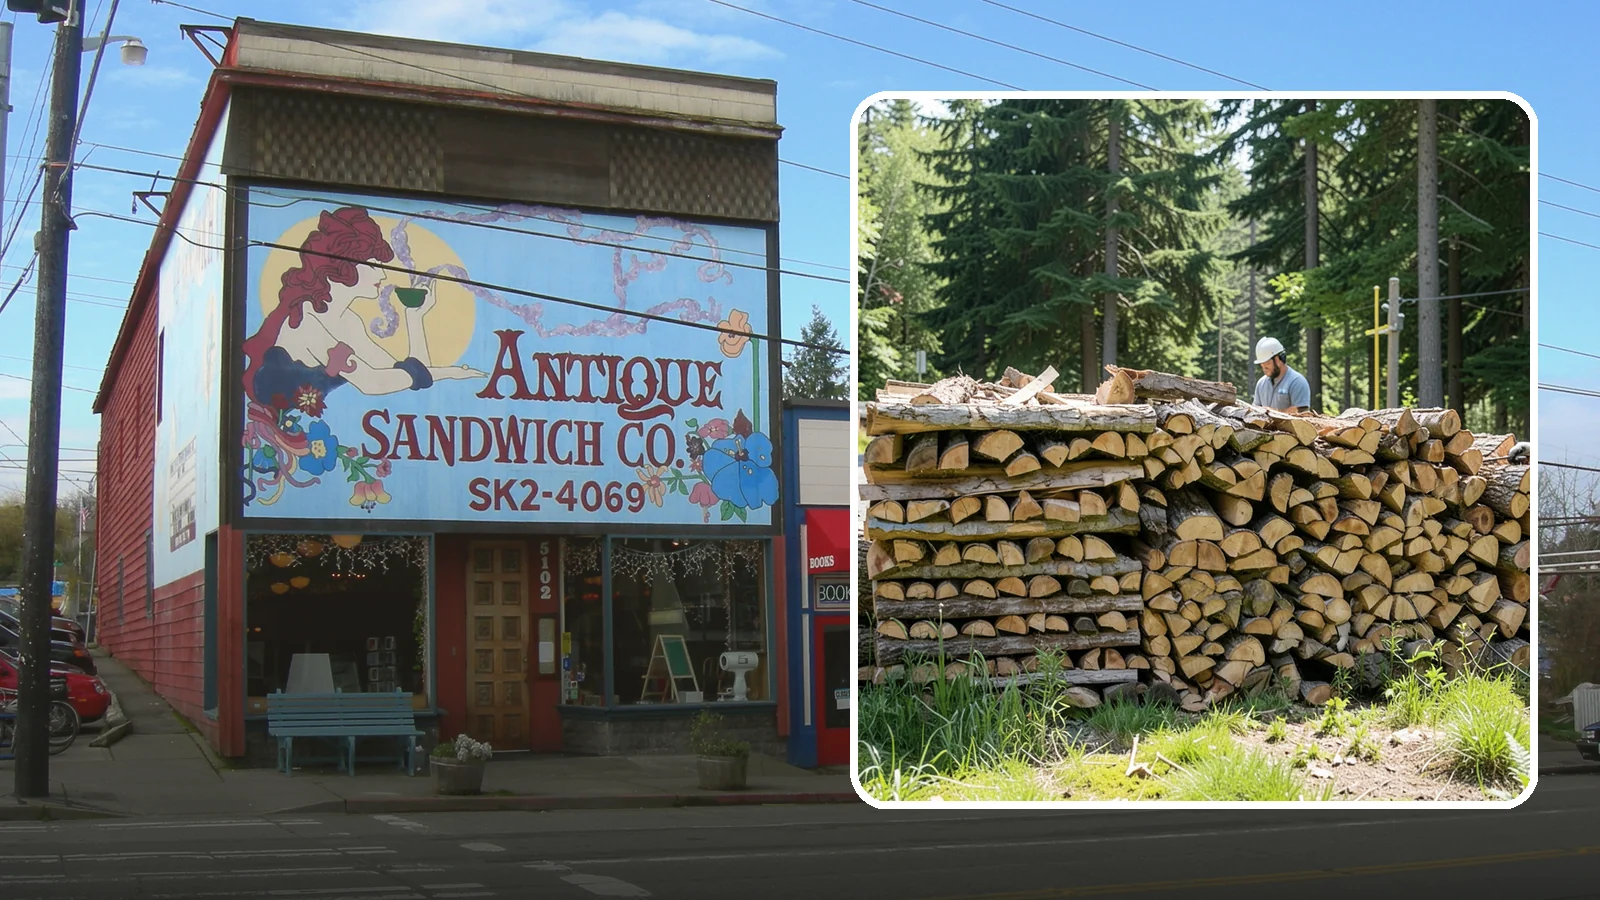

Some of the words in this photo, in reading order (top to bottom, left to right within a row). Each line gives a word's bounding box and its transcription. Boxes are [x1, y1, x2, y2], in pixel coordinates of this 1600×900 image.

[361, 408, 605, 467] SANDWICH
[617, 422, 685, 468] CO.
[468, 477, 646, 513] SK2-4069
[540, 541, 551, 599] 5102
[809, 555, 835, 569] BOOKS
